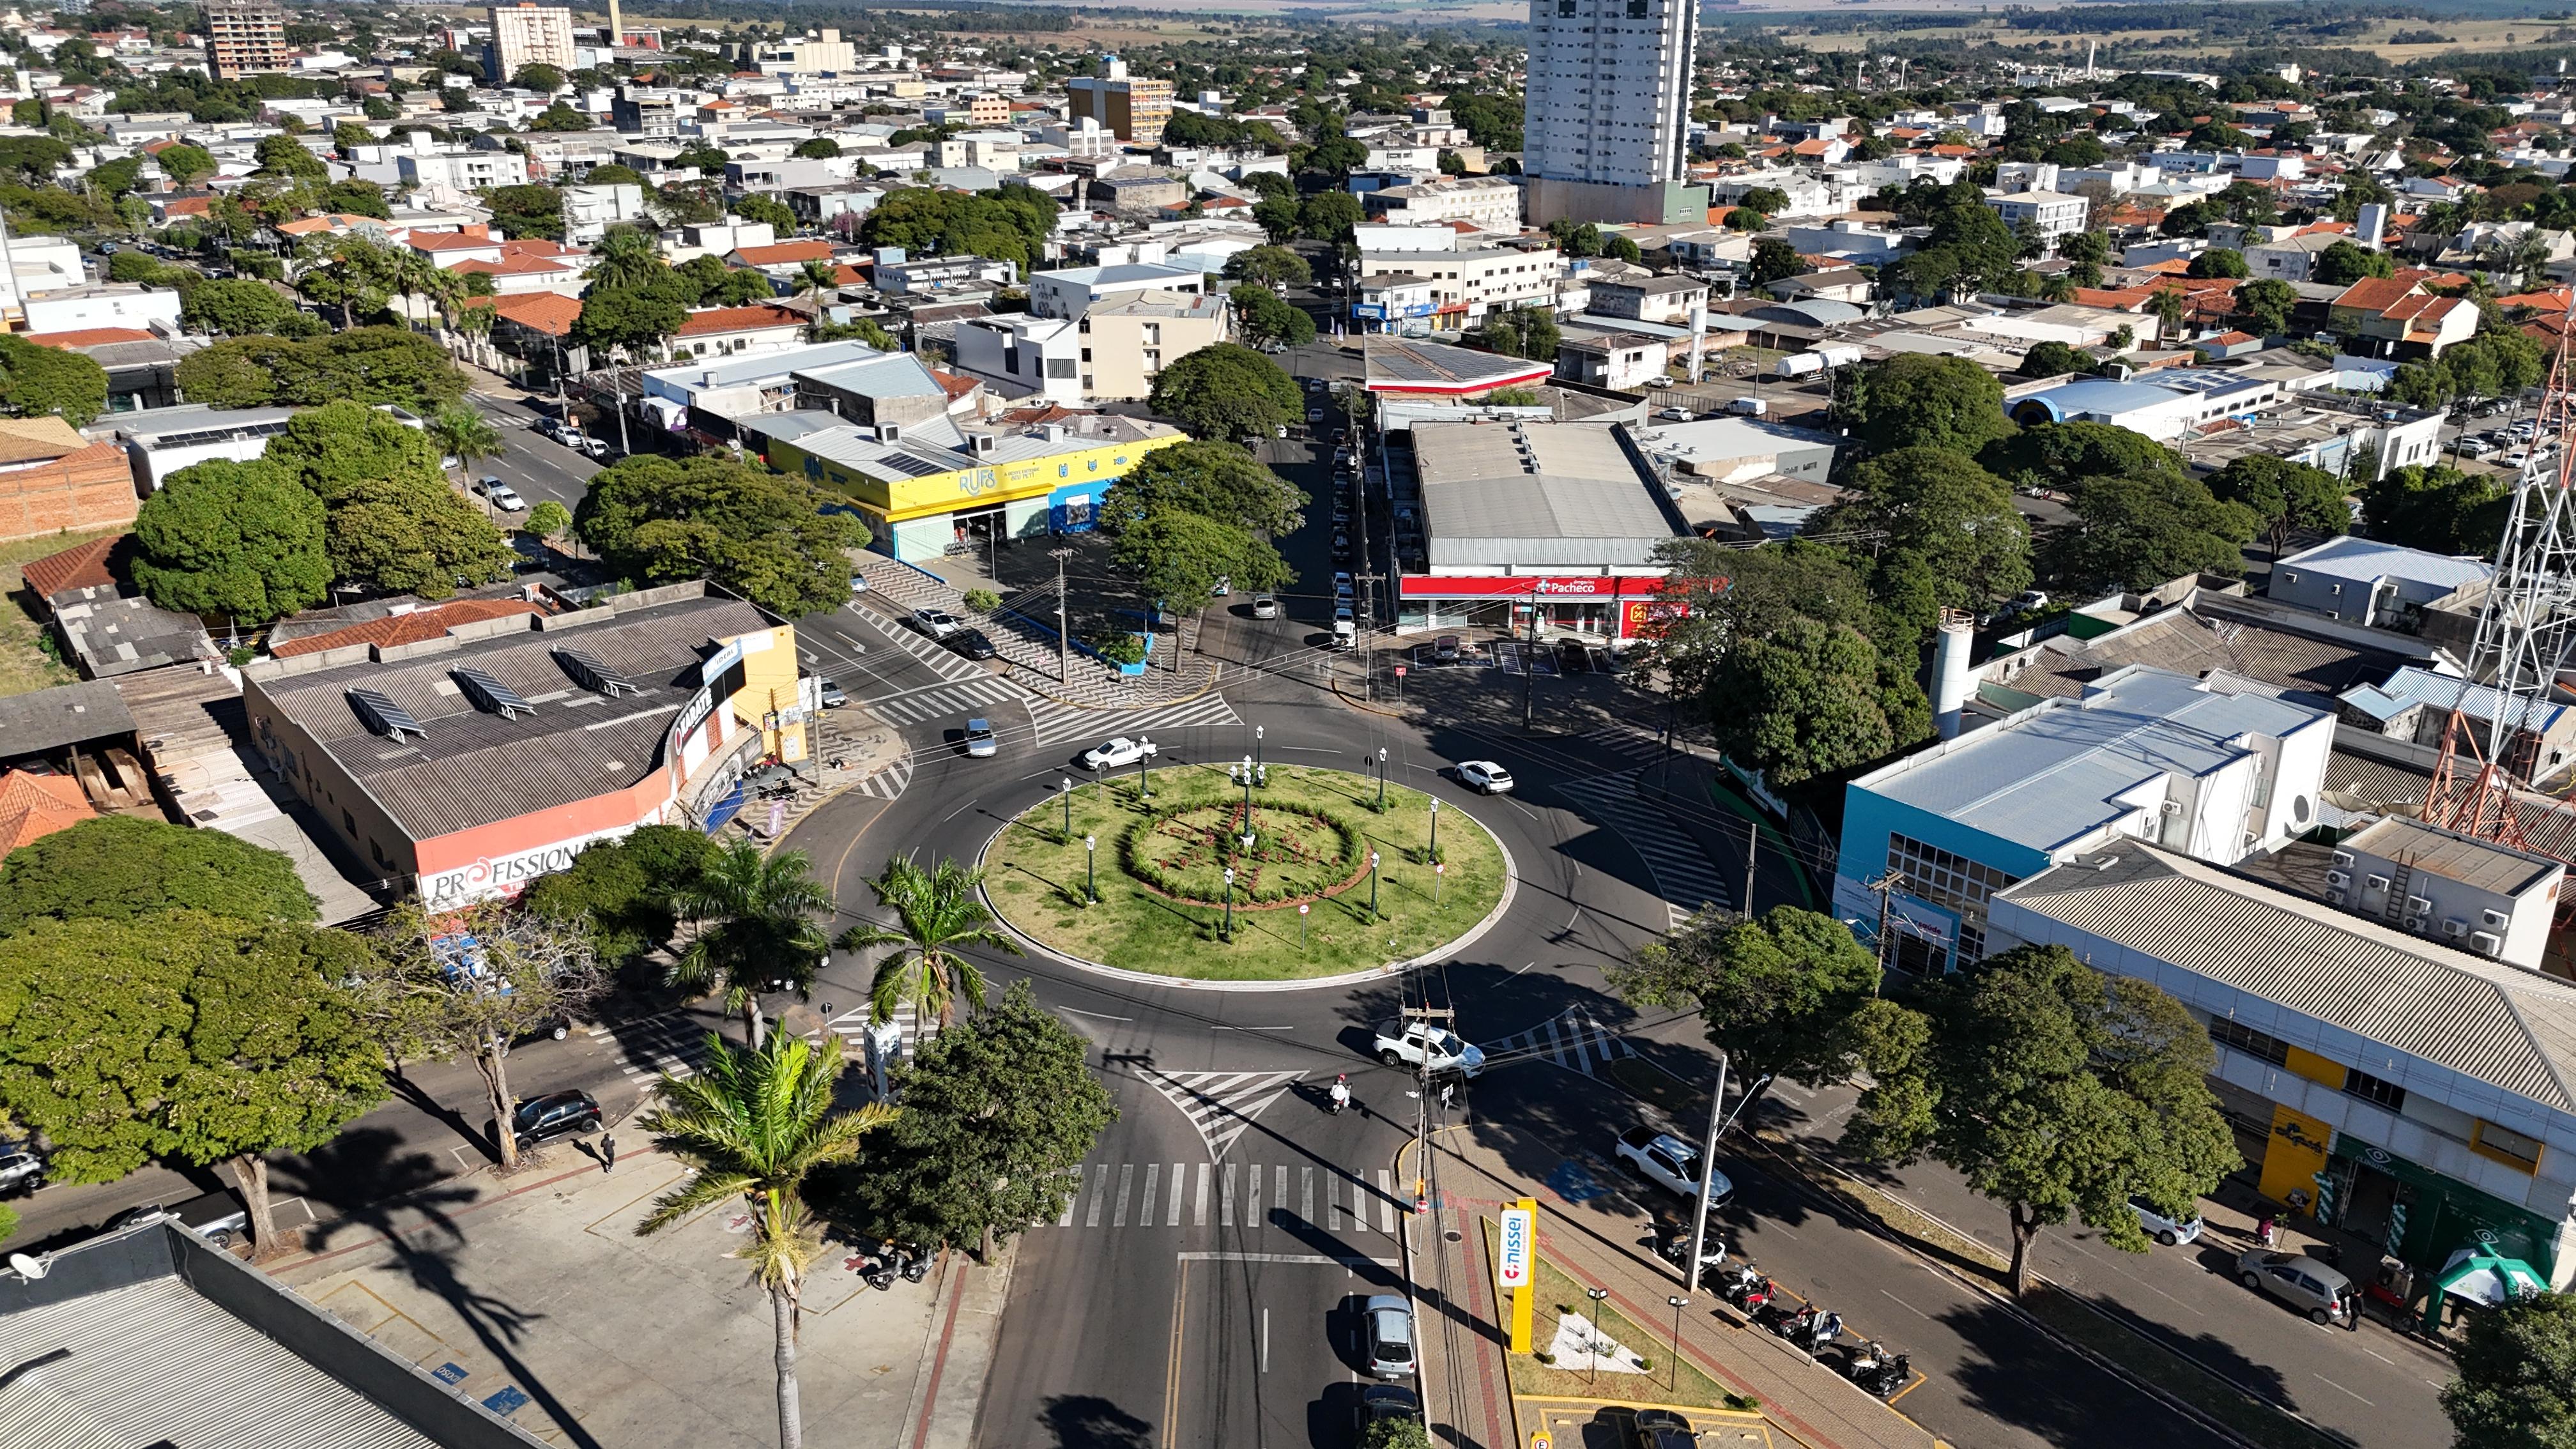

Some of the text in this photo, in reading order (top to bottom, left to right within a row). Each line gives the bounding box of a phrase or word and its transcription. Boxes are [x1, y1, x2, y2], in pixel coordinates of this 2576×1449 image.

[960, 470, 996, 496] RUFS
[1552, 582, 1595, 593] Pacheco
[435, 844, 579, 895] PROFISSION
[1507, 1217, 1521, 1264] nissei
